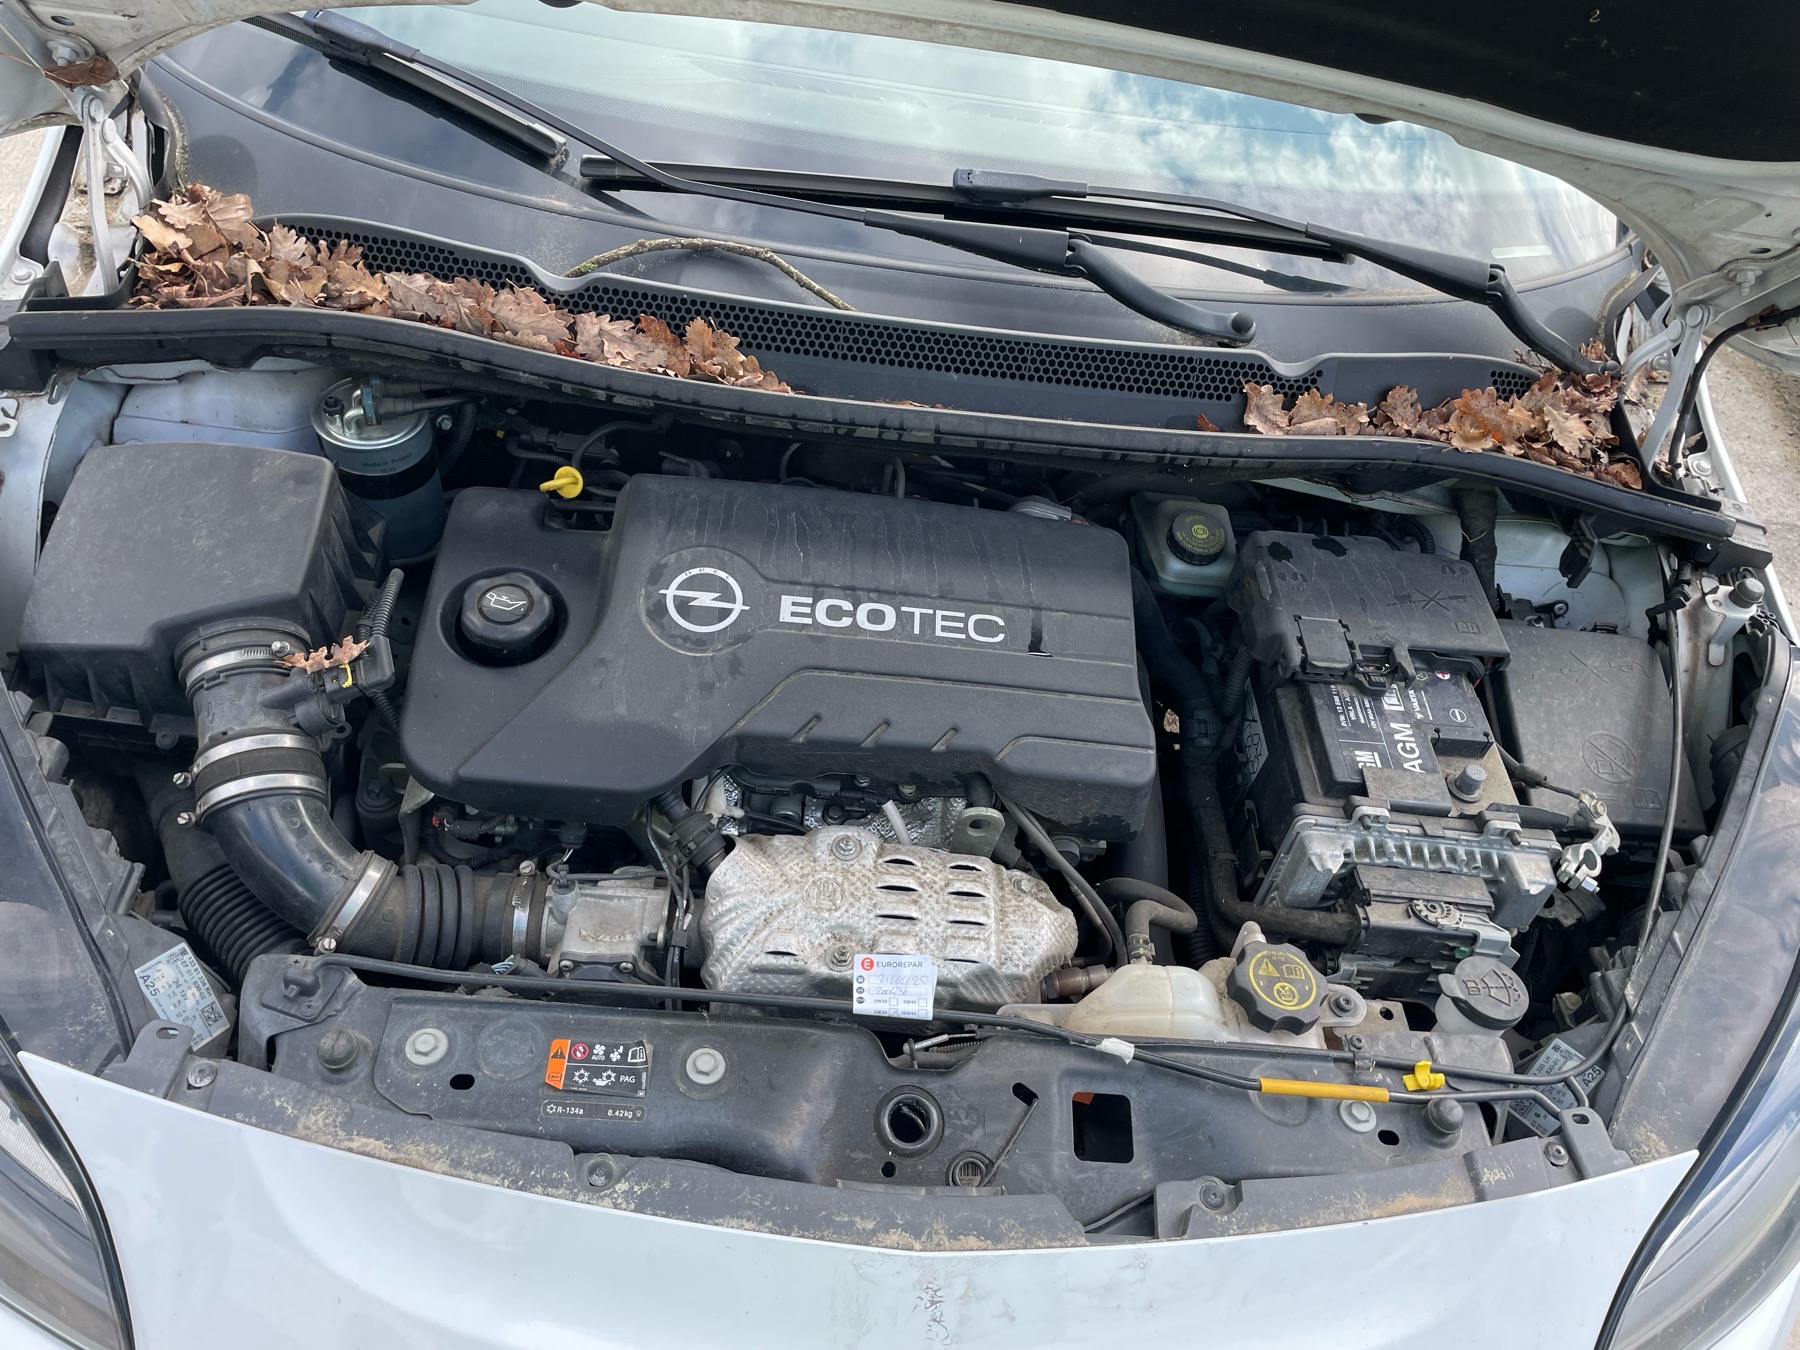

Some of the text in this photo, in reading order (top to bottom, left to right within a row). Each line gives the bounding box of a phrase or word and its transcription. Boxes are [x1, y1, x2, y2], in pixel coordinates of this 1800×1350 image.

[390, 452, 412, 464] Poland
[779, 594, 1006, 643] ECOTEC
[1408, 689, 1420, 712] VARTA
[1389, 722, 1426, 774] AGM
[139, 974, 161, 997] A25
[1542, 1056, 1551, 1065] LH
[619, 1075, 636, 1083] PAG
[1581, 1066, 1602, 1087] A25
[556, 1106, 584, 1115] R-134a
[607, 1109, 633, 1118] 0.42kg
